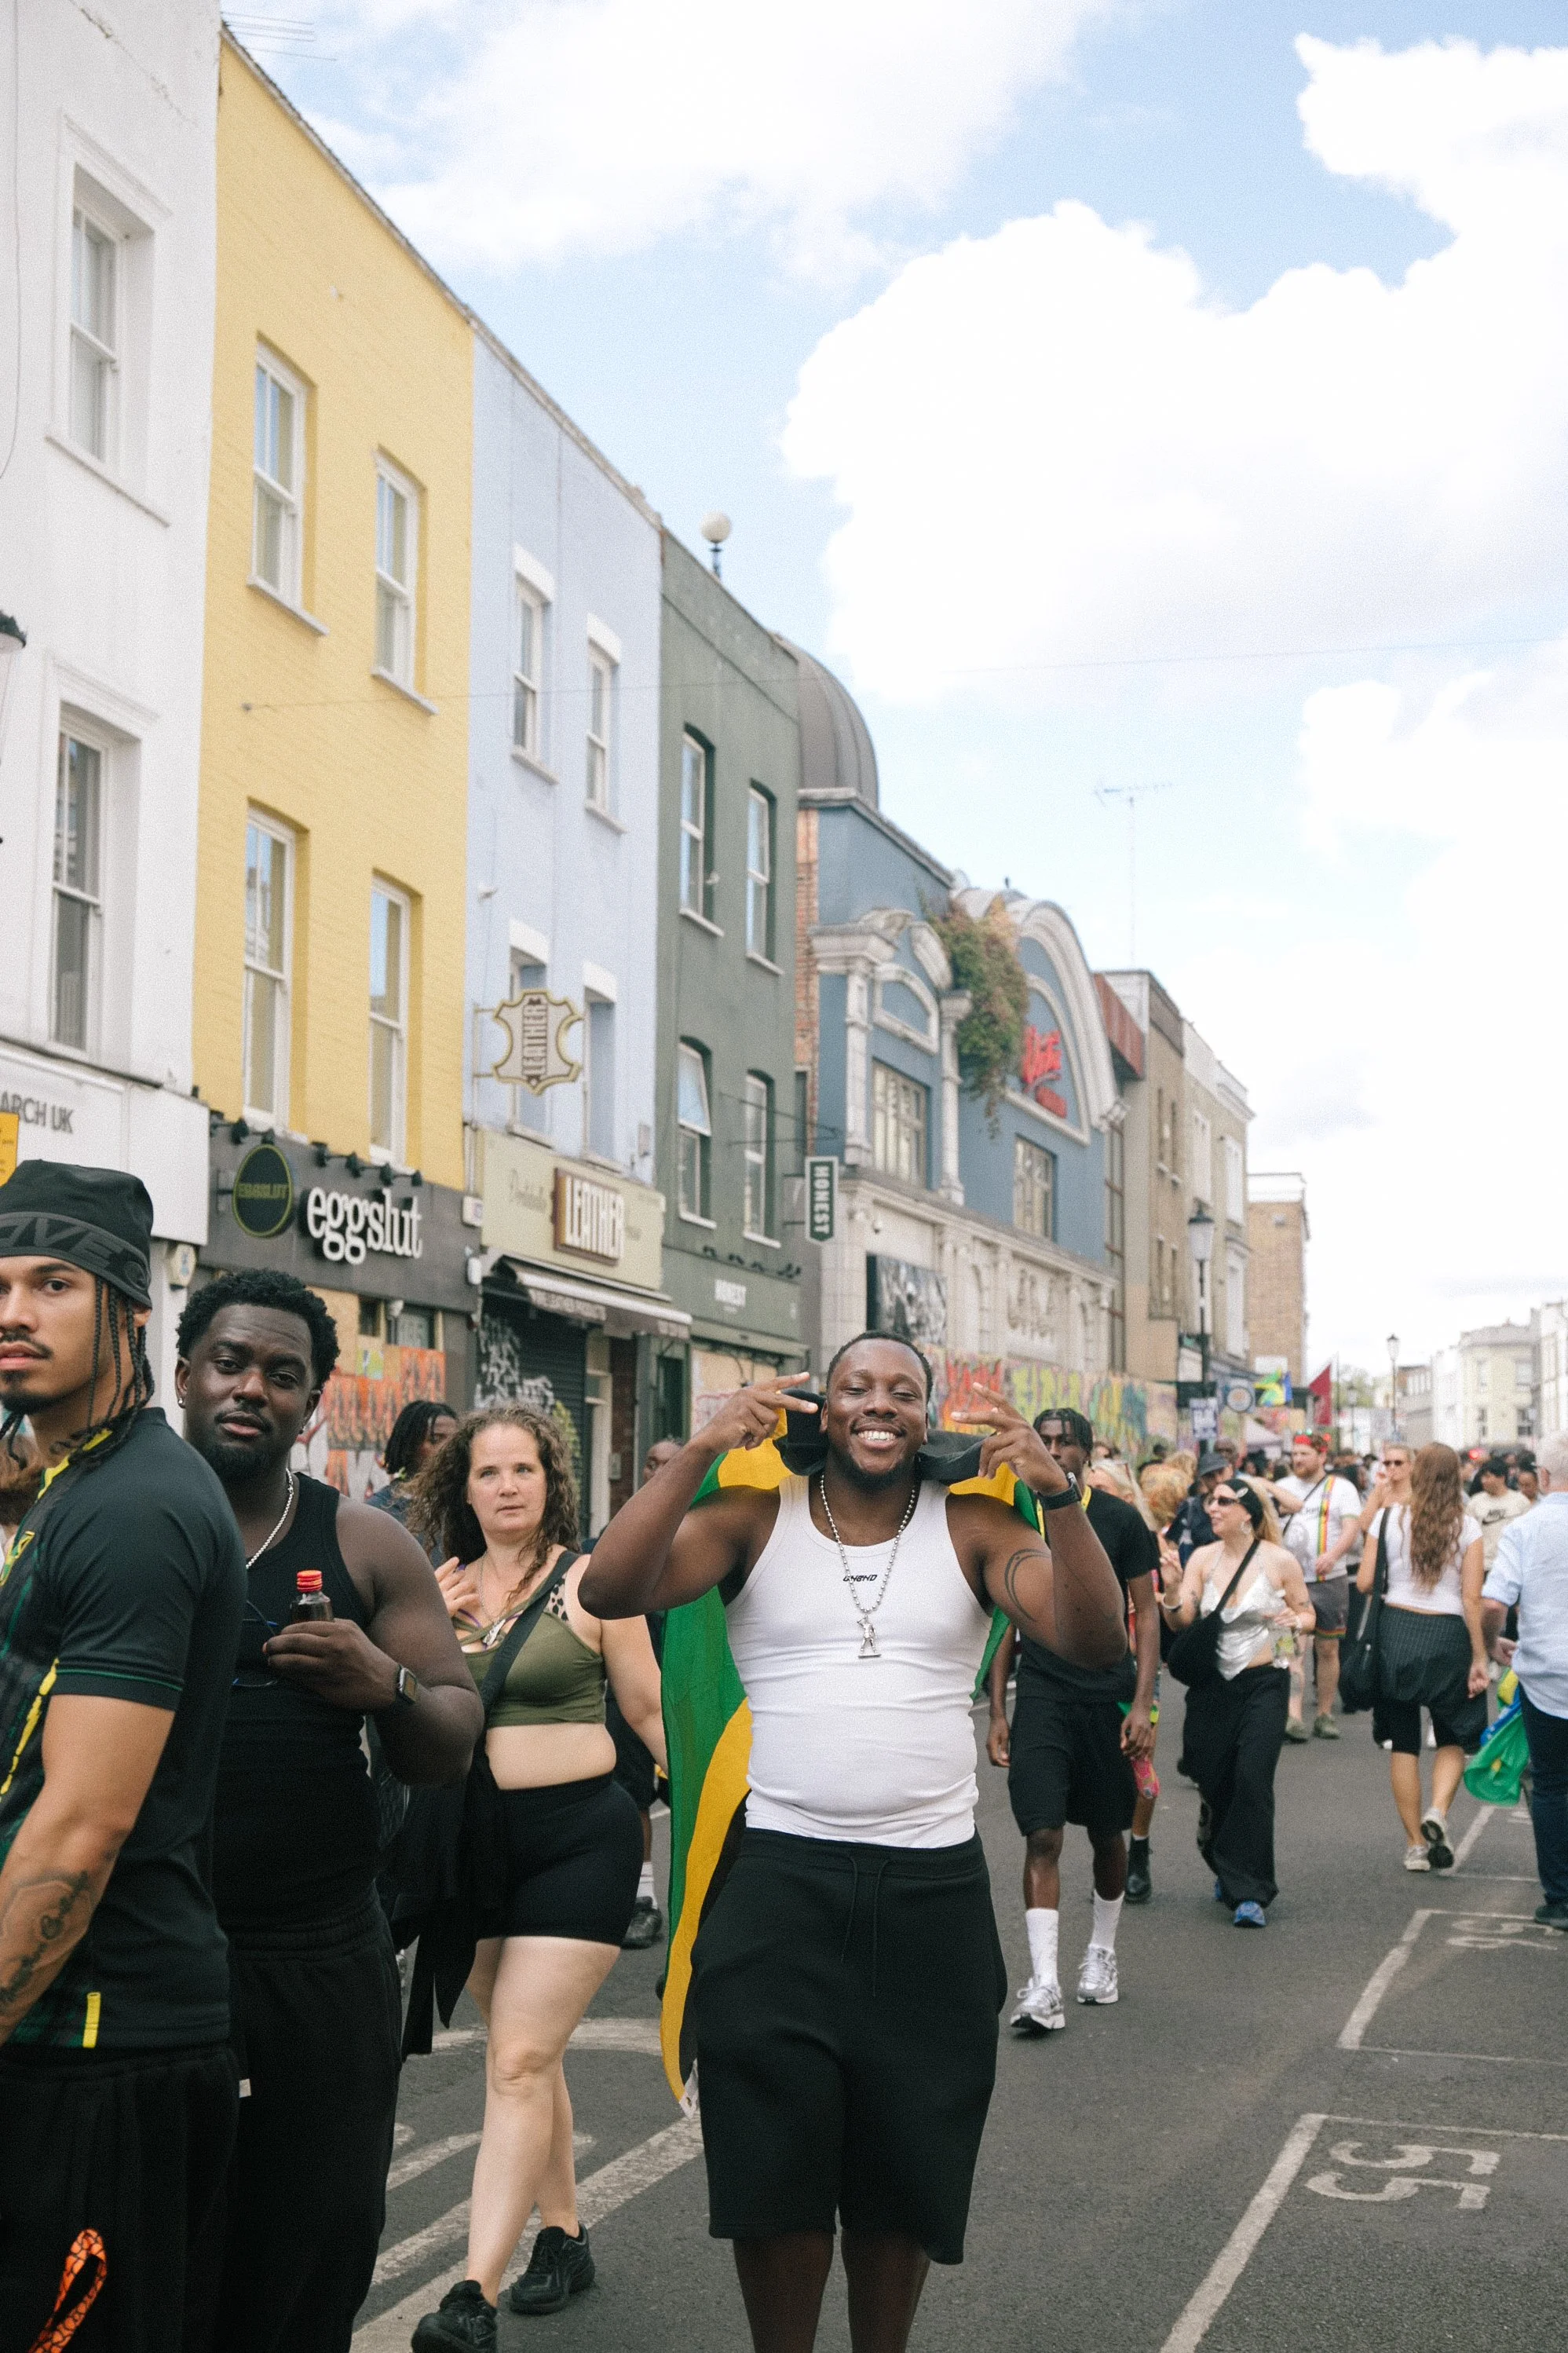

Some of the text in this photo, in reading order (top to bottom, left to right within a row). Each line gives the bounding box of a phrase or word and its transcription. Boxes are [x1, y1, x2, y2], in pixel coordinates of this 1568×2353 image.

[51, 1104, 74, 1134] UK
[307, 1186, 423, 1265] eggslut
[565, 1174, 624, 1260] LEATHER
[813, 1166, 831, 1235] HONEST
[1304, 2140, 1501, 2209] 55
